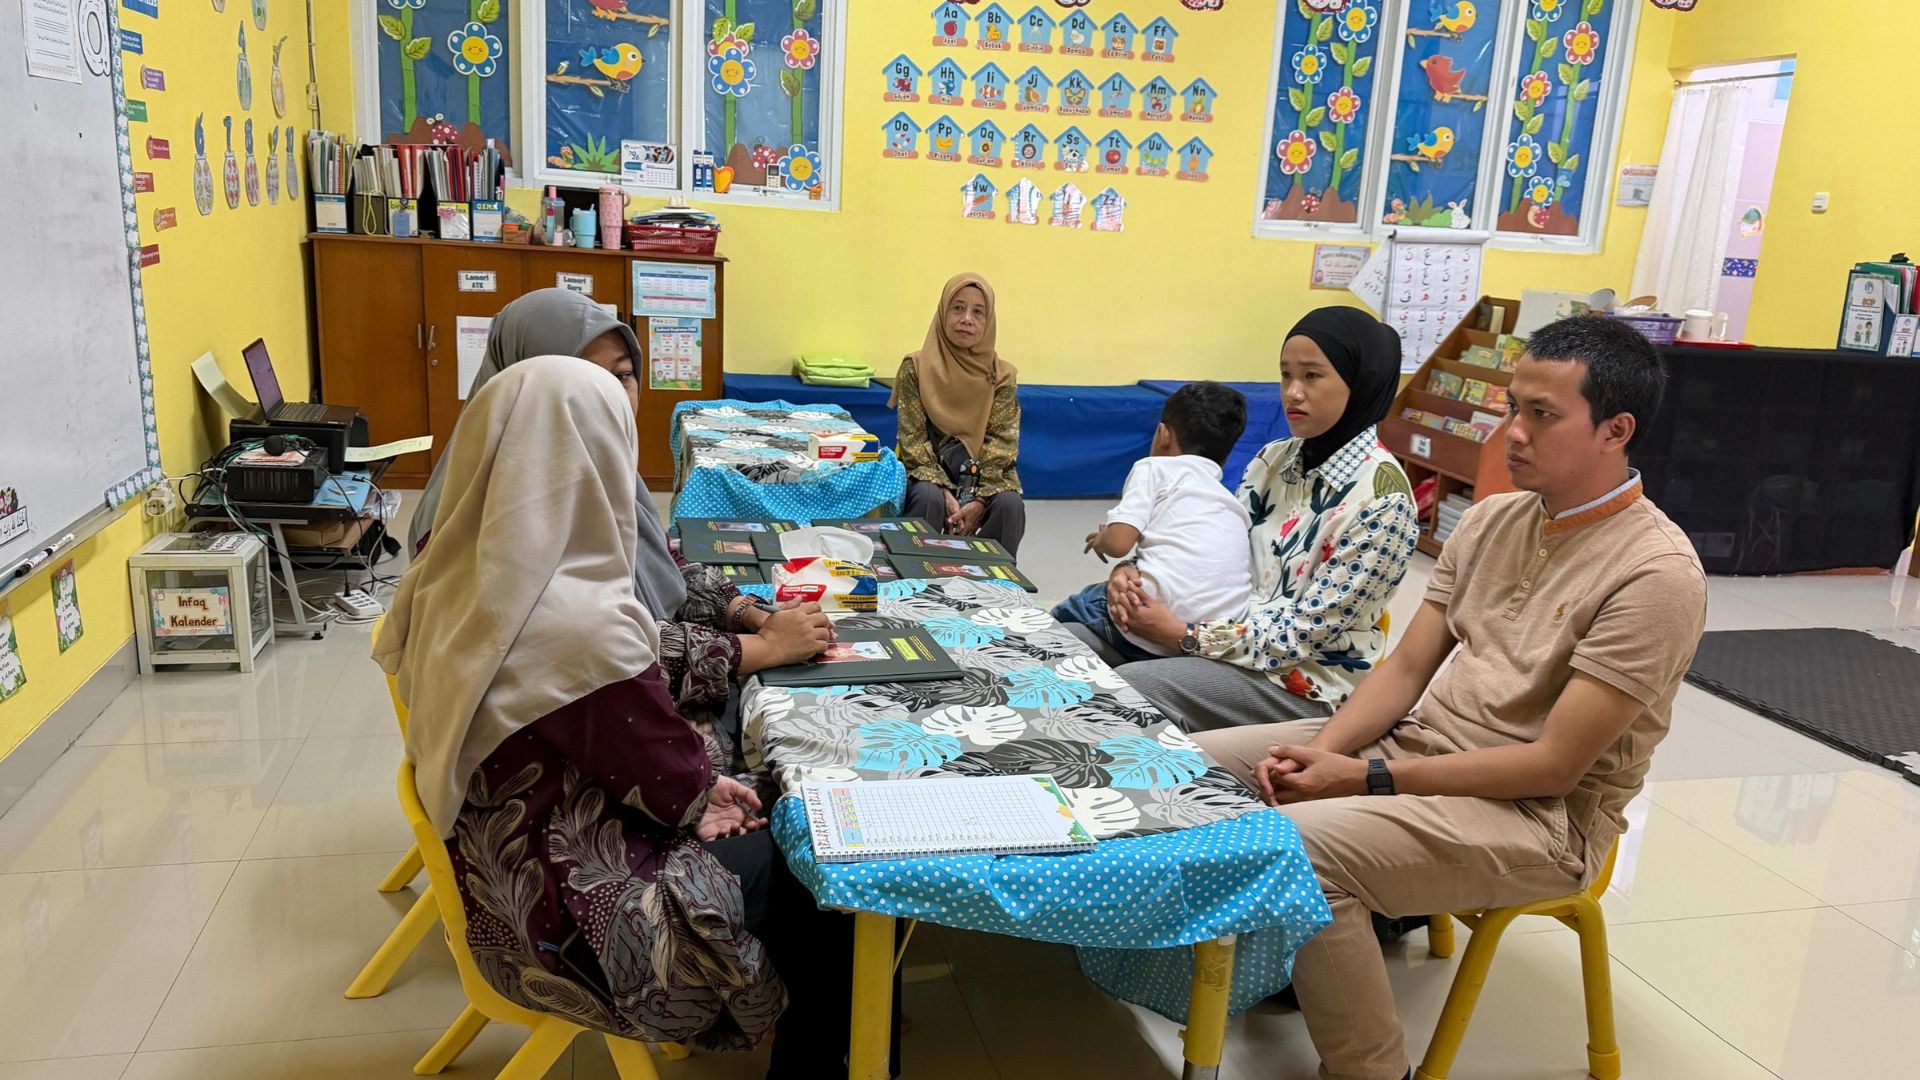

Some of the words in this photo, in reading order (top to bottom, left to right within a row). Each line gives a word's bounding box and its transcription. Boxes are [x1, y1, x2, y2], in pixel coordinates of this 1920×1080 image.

[944, 7, 958, 19] Aa
[987, 12, 1002, 24] Bb
[1029, 15, 1043, 27] Cc
[1071, 18, 1086, 30] Dd
[1113, 22, 1127, 33] Ee
[1154, 25, 1167, 37] Ff
[895, 63, 910, 78] Gg
[940, 67, 955, 80] Hh
[987, 72, 995, 83] Ii
[1027, 74, 1038, 88] Jj
[1069, 77, 1082, 89] Kk
[1112, 80, 1122, 91] Ll
[1150, 83, 1166, 95] Mm
[1192, 86, 1206, 97] Nn
[895, 120, 909, 131] Oo
[938, 123, 953, 137] Pp
[980, 127, 995, 142] Qq
[1023, 131, 1036, 143] Rr
[1066, 134, 1080, 145] Ss
[1109, 137, 1121, 148] Tt
[1149, 140, 1162, 151] Uu
[1189, 144, 1202, 155] Vv
[178, 596, 208, 611] Infaq
[170, 615, 217, 627] Kalender
